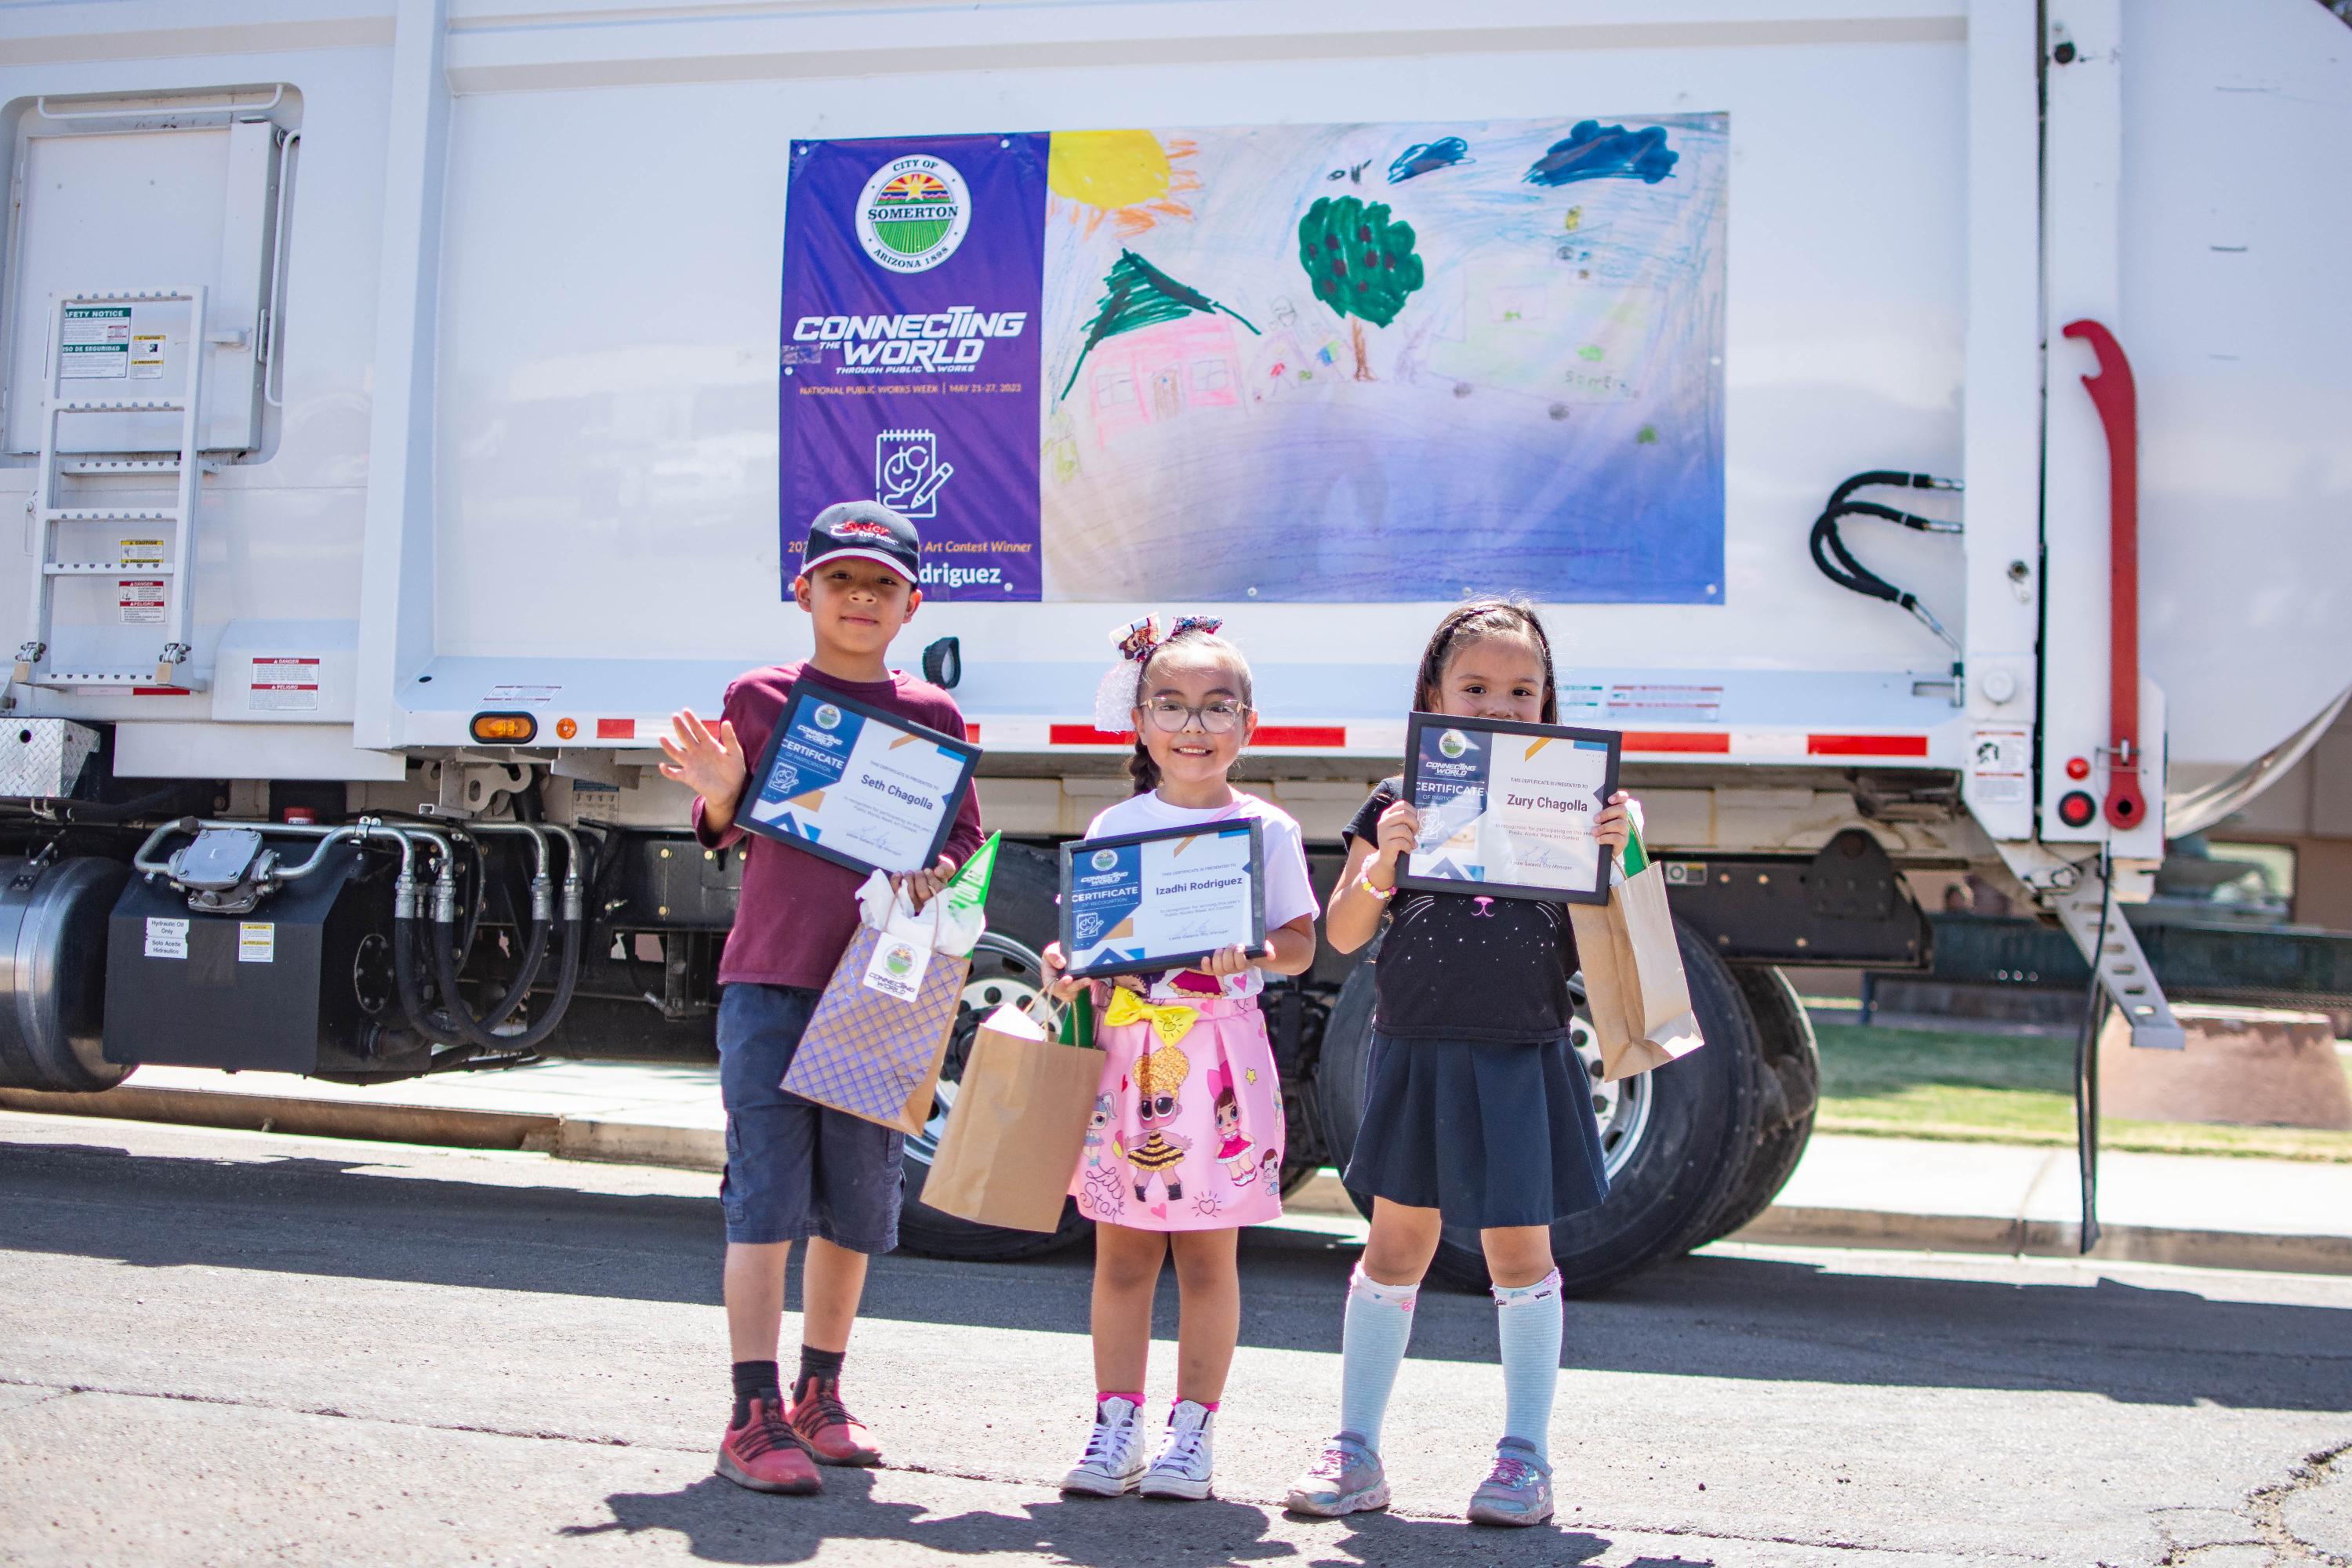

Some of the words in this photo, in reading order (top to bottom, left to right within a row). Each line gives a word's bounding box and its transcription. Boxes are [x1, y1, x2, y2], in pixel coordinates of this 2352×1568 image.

[893, 159, 920, 172] CITY
[922, 160, 938, 169] OF
[868, 205, 959, 220] SOMERTON
[873, 249, 921, 268] ARIZONA
[925, 246, 949, 265] 1898
[793, 305, 1027, 341] CONNECTING
[819, 341, 841, 350] THE
[843, 339, 985, 373] WORLD
[836, 366, 883, 375] THROUGH
[885, 365, 923, 374] PUBLIC
[800, 386, 843, 395] NATIONAL
[846, 385, 875, 394] PUBLIC
[877, 384, 910, 394] WORKS
[913, 383, 938, 394] WEEK
[949, 383, 969, 393] MAY
[924, 541, 943, 554] Art
[946, 541, 988, 554] Contest
[991, 540, 1033, 554] Winner
[919, 562, 1001, 588] driguez
[781, 739, 845, 769] CERTIFICATE
[1426, 761, 1476, 771] CONNECTING
[861, 774, 885, 791] Seth
[887, 785, 933, 810] Chagolla
[1416, 782, 1485, 797] CERTIFICATE
[1507, 793, 1534, 809] Zury
[1537, 797, 1588, 813] Chagolla
[1072, 887, 1138, 902] CERTIFICATE
[1156, 883, 1187, 895] Izadhi
[1190, 877, 1243, 891] Rodriguez
[868, 972, 916, 993] CONNECTING
[877, 981, 906, 995] WORLD
[1086, 1163, 1124, 1215] Little
[1080, 1182, 1122, 1225] Star
